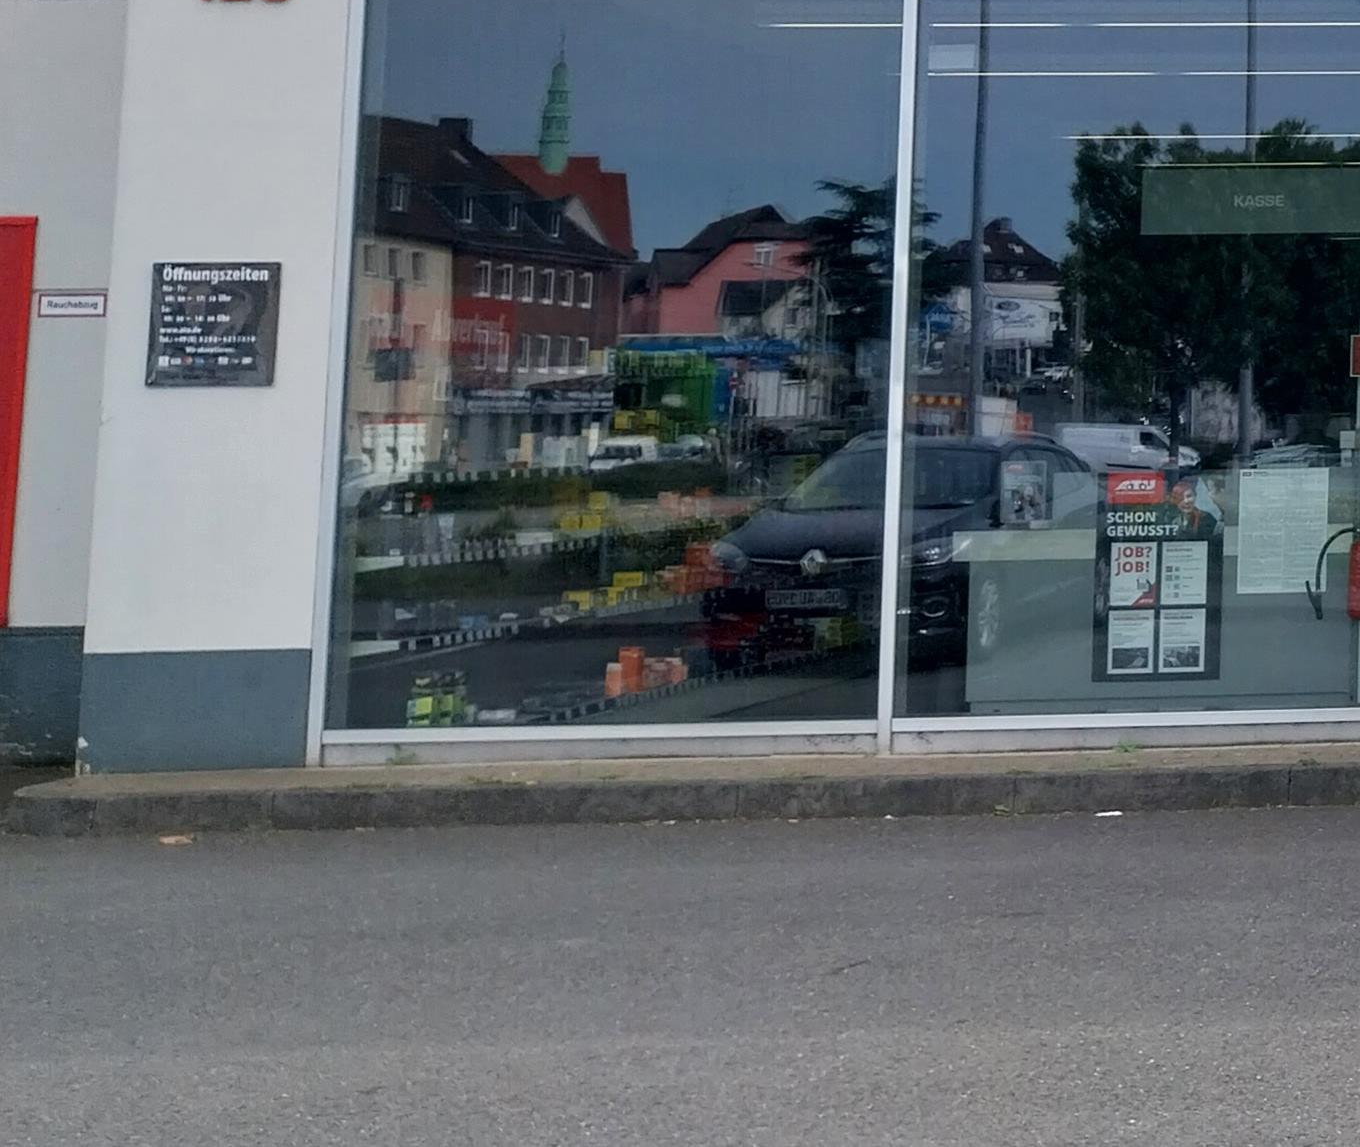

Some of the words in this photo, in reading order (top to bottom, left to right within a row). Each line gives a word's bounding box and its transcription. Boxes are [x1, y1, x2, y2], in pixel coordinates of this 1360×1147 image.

[1233, 195, 1285, 207] KASSE
[162, 264, 269, 284] Öffnungszeiten
[1106, 511, 1156, 524] SCHON
[1106, 525, 1179, 537] GEWUSST?
[1115, 546, 1152, 561] JOB?
[1115, 561, 1150, 576] JOB!
